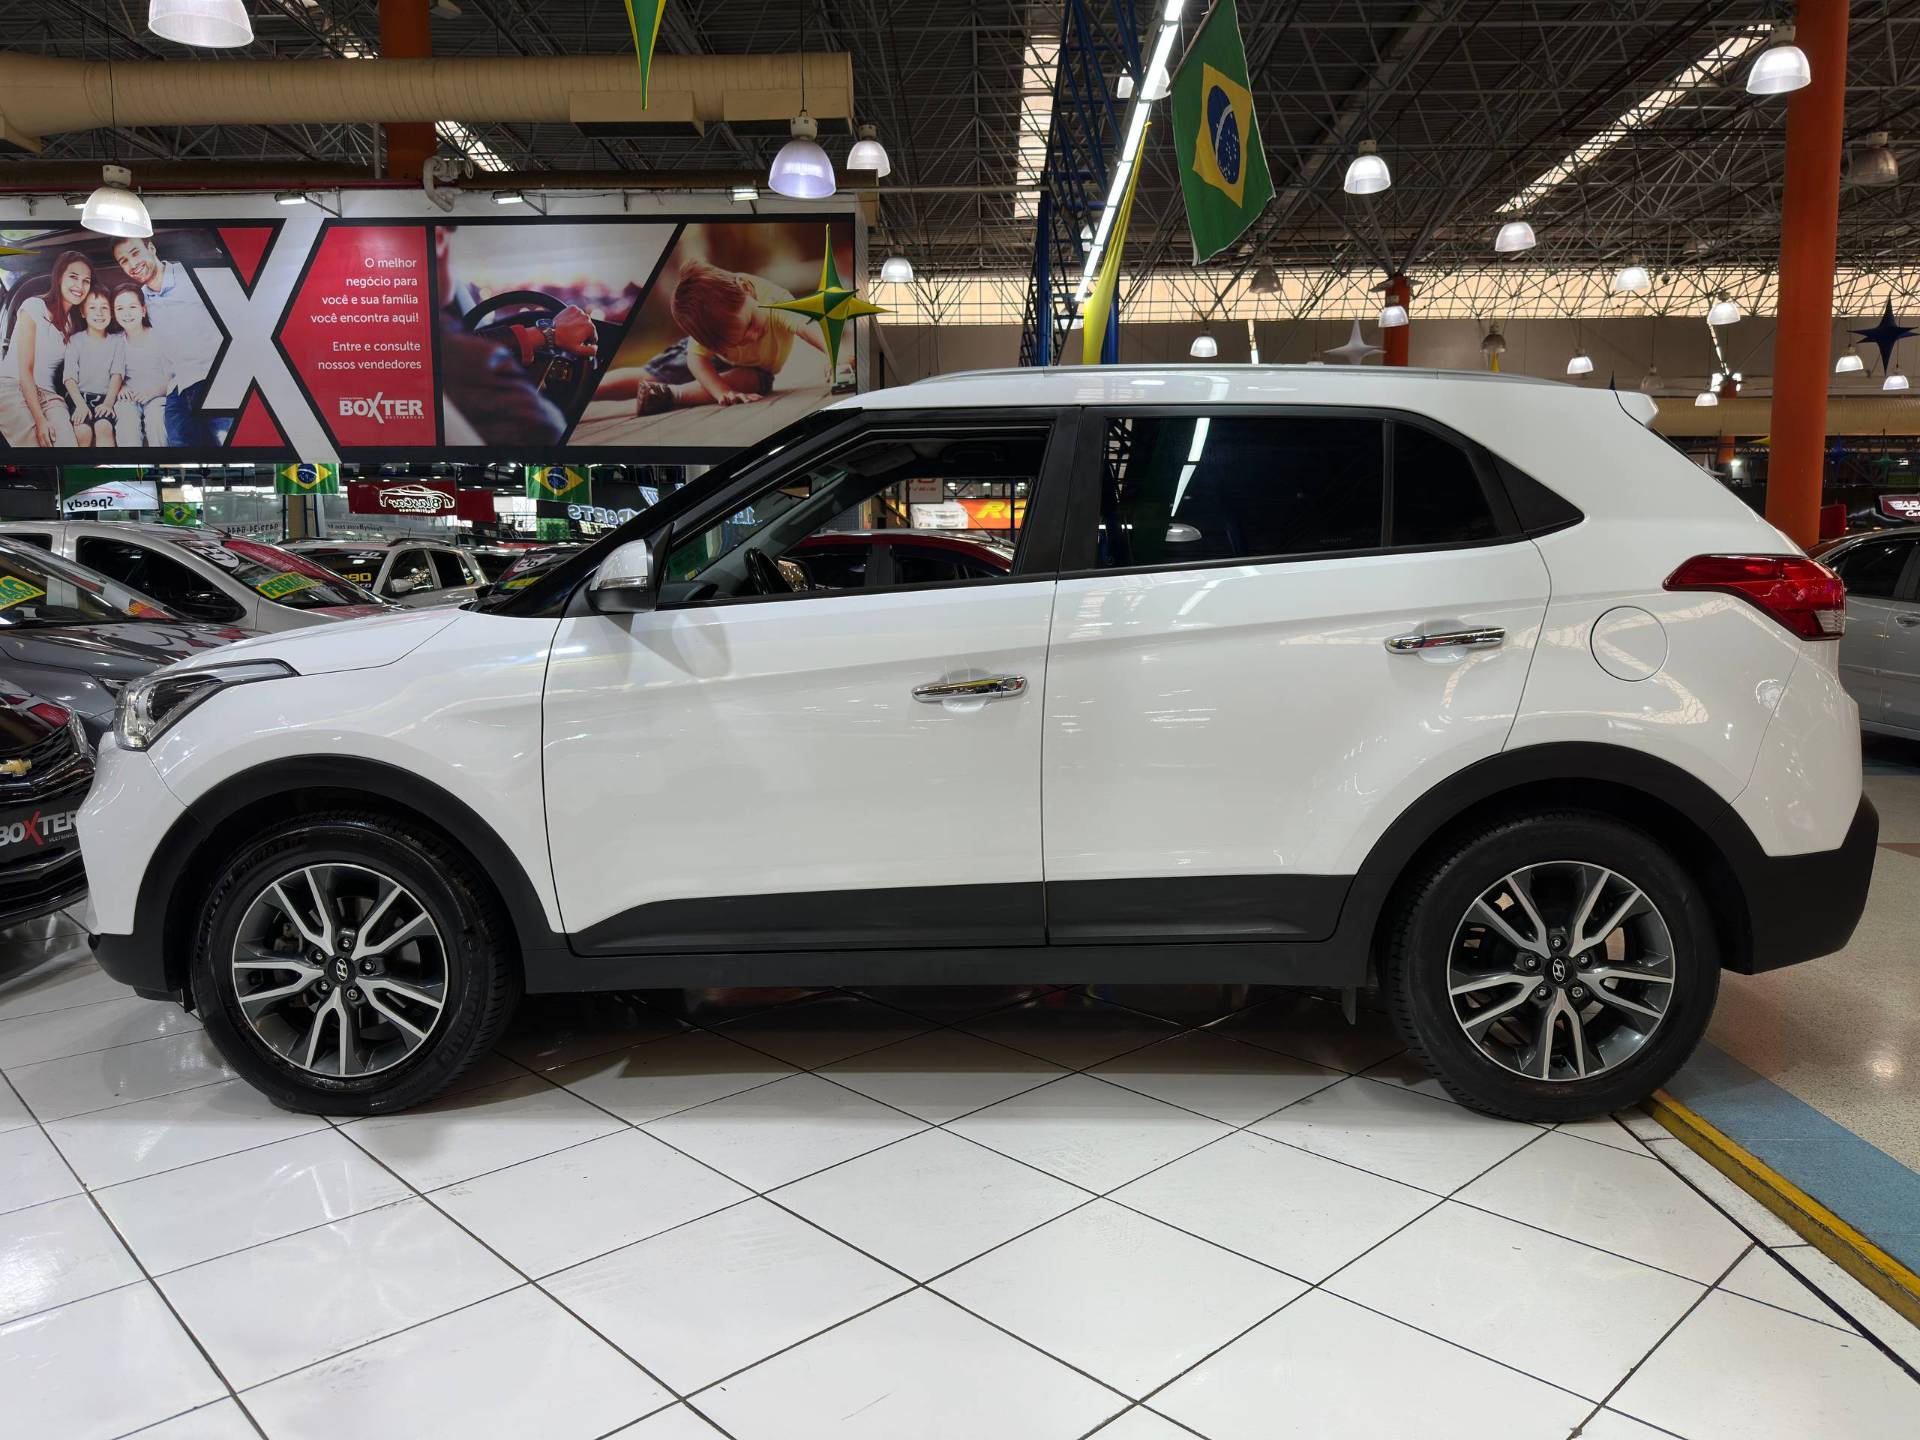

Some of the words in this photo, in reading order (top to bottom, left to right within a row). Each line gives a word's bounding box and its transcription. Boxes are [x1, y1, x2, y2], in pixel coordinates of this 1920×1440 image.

[364, 257, 375, 268] O
[377, 257, 417, 268] melhor
[346, 276, 391, 288] negócio
[393, 278, 418, 288] para
[321, 294, 349, 305] você
[351, 296, 358, 305] e
[360, 296, 380, 305] sua
[382, 294, 418, 305] família
[310, 313, 338, 323] você
[340, 314, 389, 323] encontra
[392, 312, 419, 324] aqui!
[332, 341, 361, 352] Entre
[364, 342, 371, 351] e
[373, 341, 421, 352] consulte
[318, 361, 356, 370] nossos
[357, 360, 422, 370] vendedores
[339, 391, 424, 424] BOXTER
